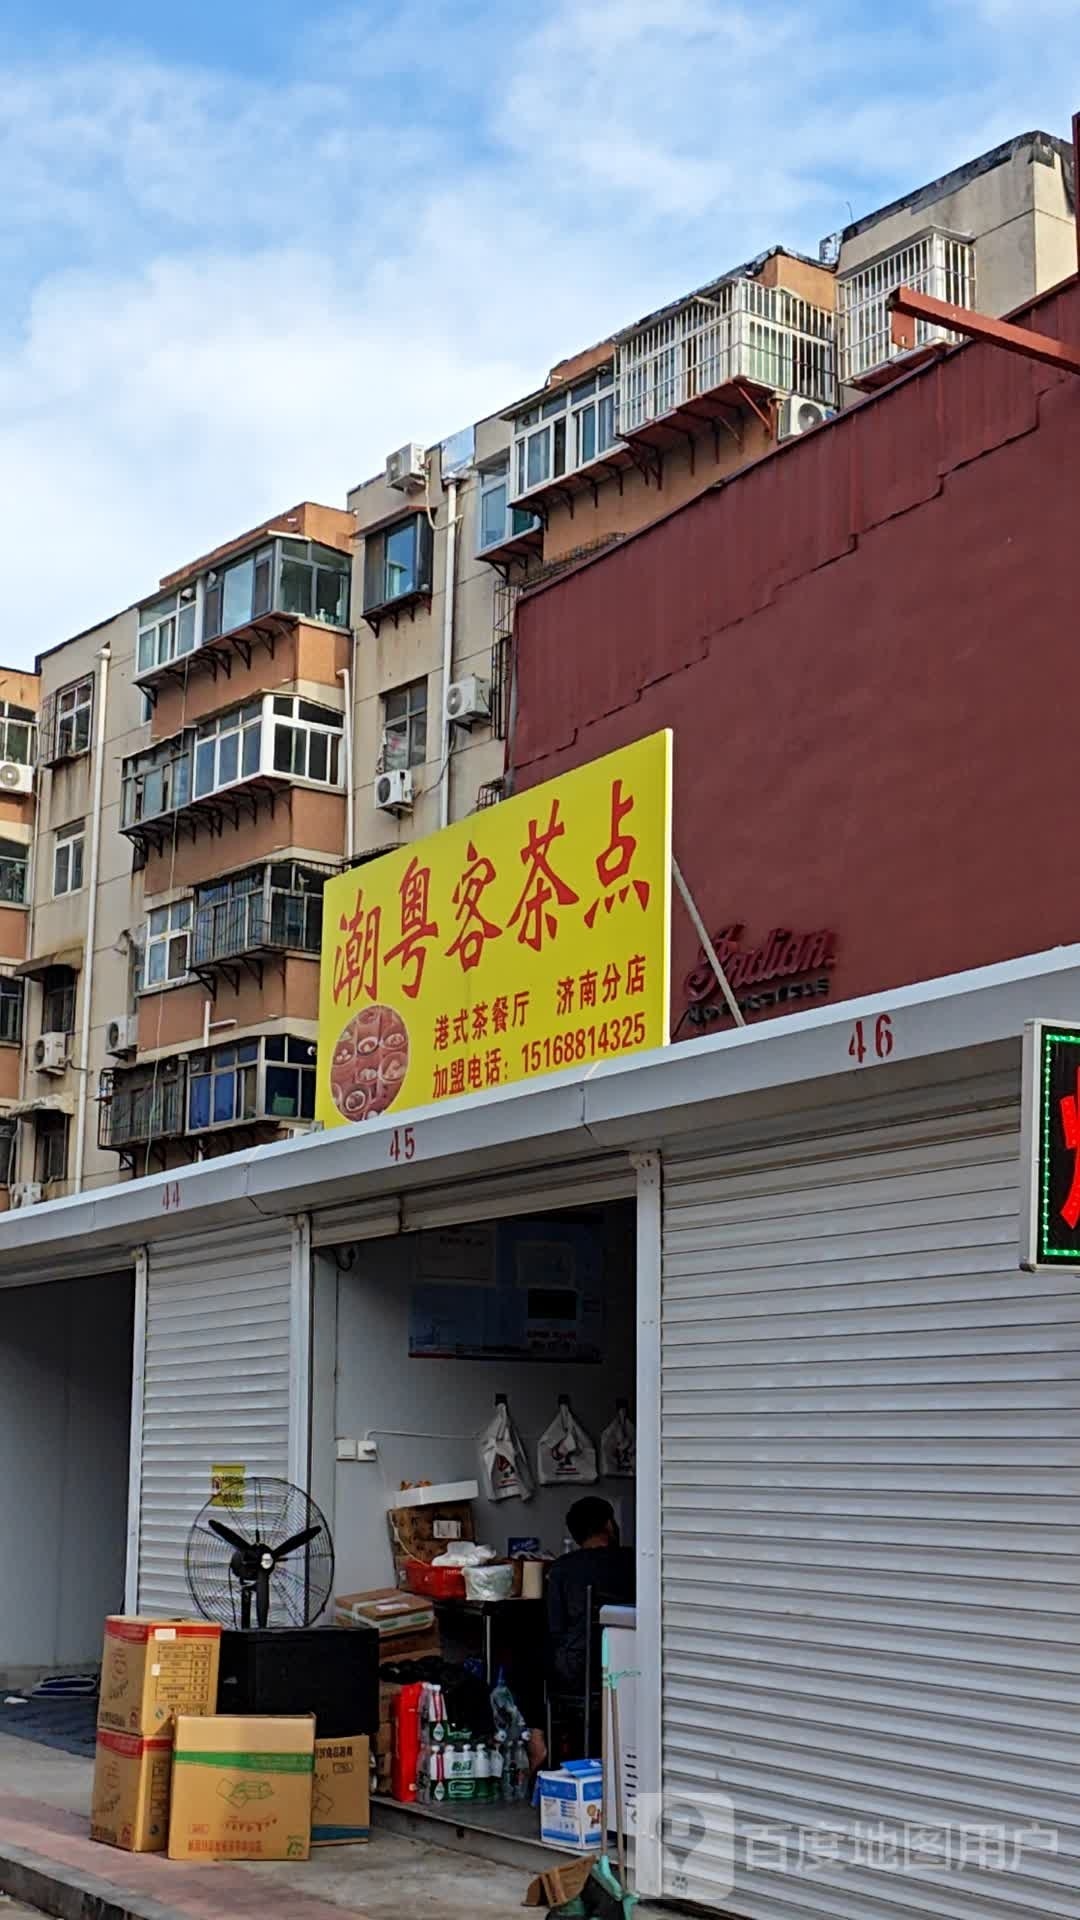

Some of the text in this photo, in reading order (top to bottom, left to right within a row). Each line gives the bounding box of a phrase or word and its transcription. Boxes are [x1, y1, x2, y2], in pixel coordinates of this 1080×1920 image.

[332, 779, 652, 1010] 潮粤客茶点
[433, 991, 530, 1051] 港式茶餐厅
[556, 953, 647, 1016] 济南分店
[848, 1013, 894, 1064] 46
[388, 1127, 416, 1161] 45
[162, 1181, 181, 1210] 44
